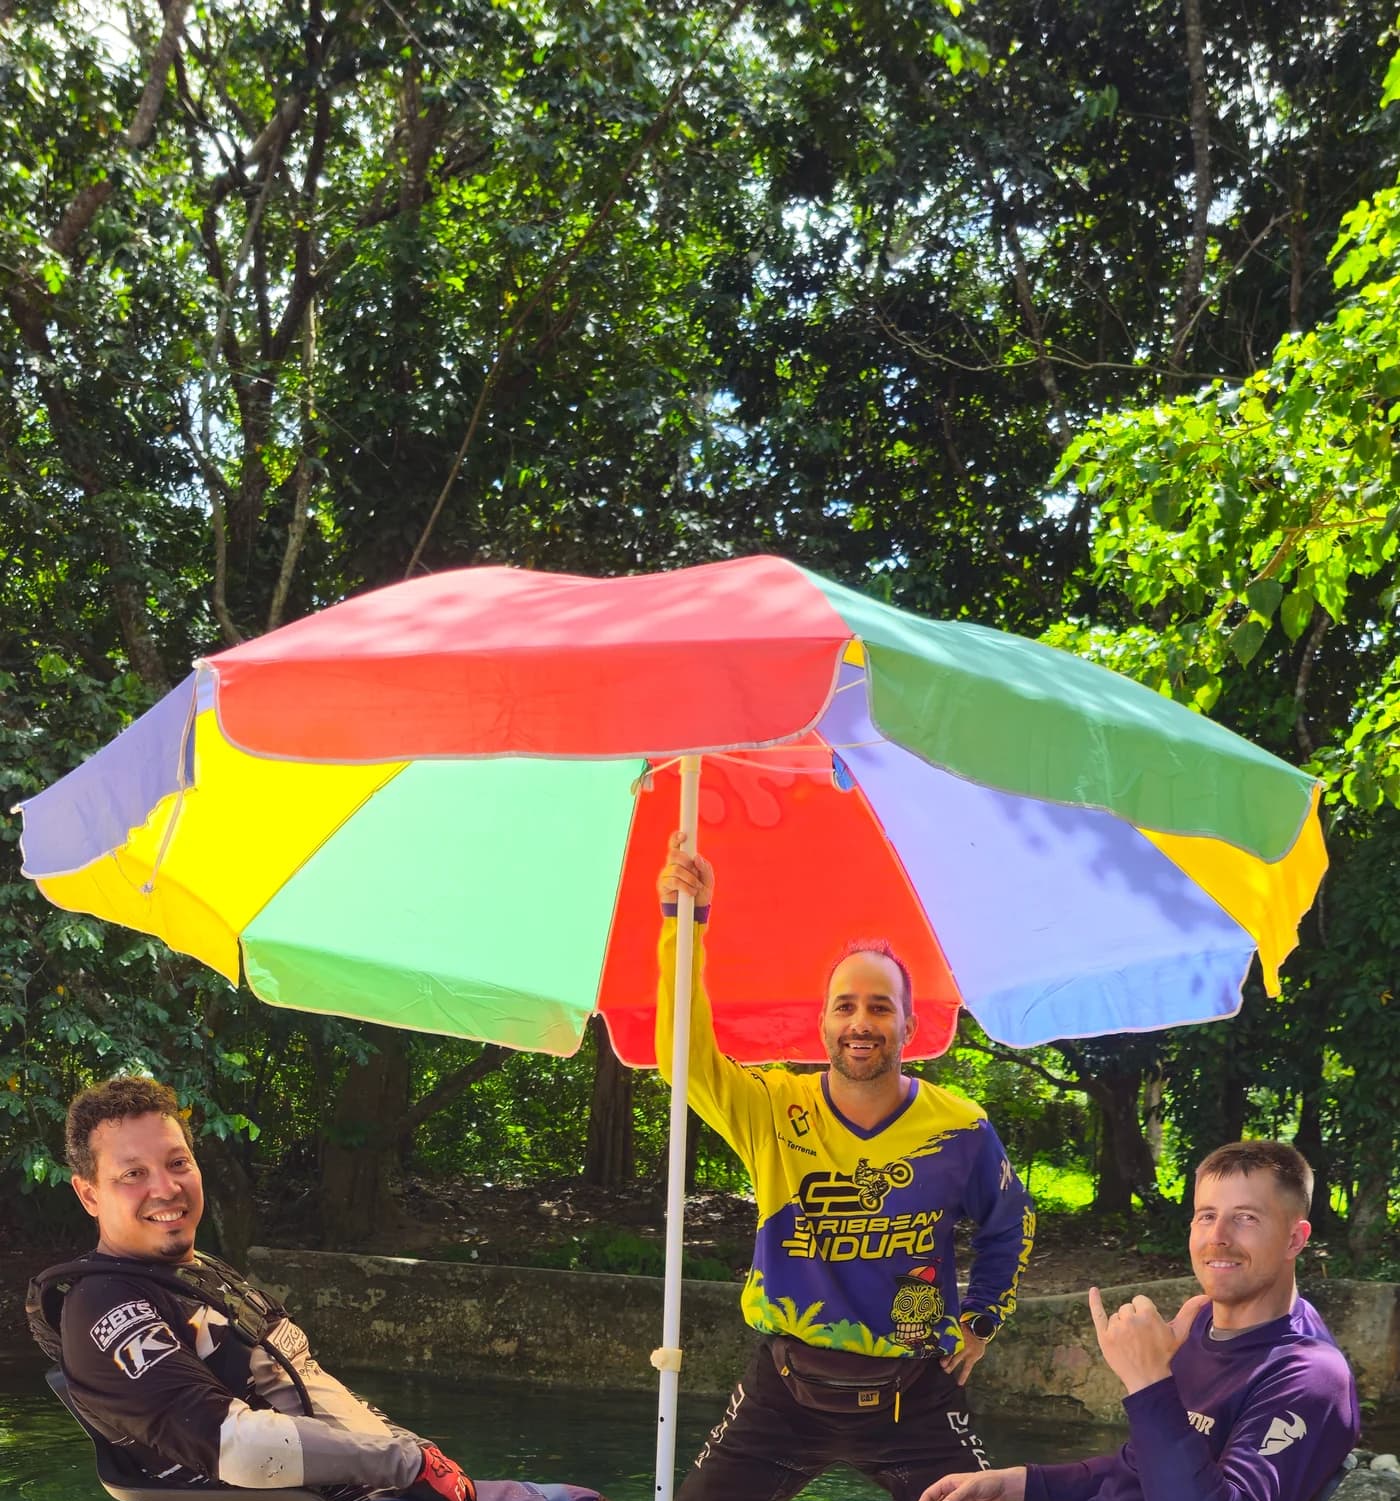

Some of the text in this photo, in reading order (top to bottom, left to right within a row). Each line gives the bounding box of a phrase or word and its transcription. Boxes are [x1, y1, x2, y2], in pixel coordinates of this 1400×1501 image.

[794, 1209, 943, 1235] CARIBBEAN
[781, 1225, 935, 1262] ENDURO
[107, 1302, 156, 1329] BTS
